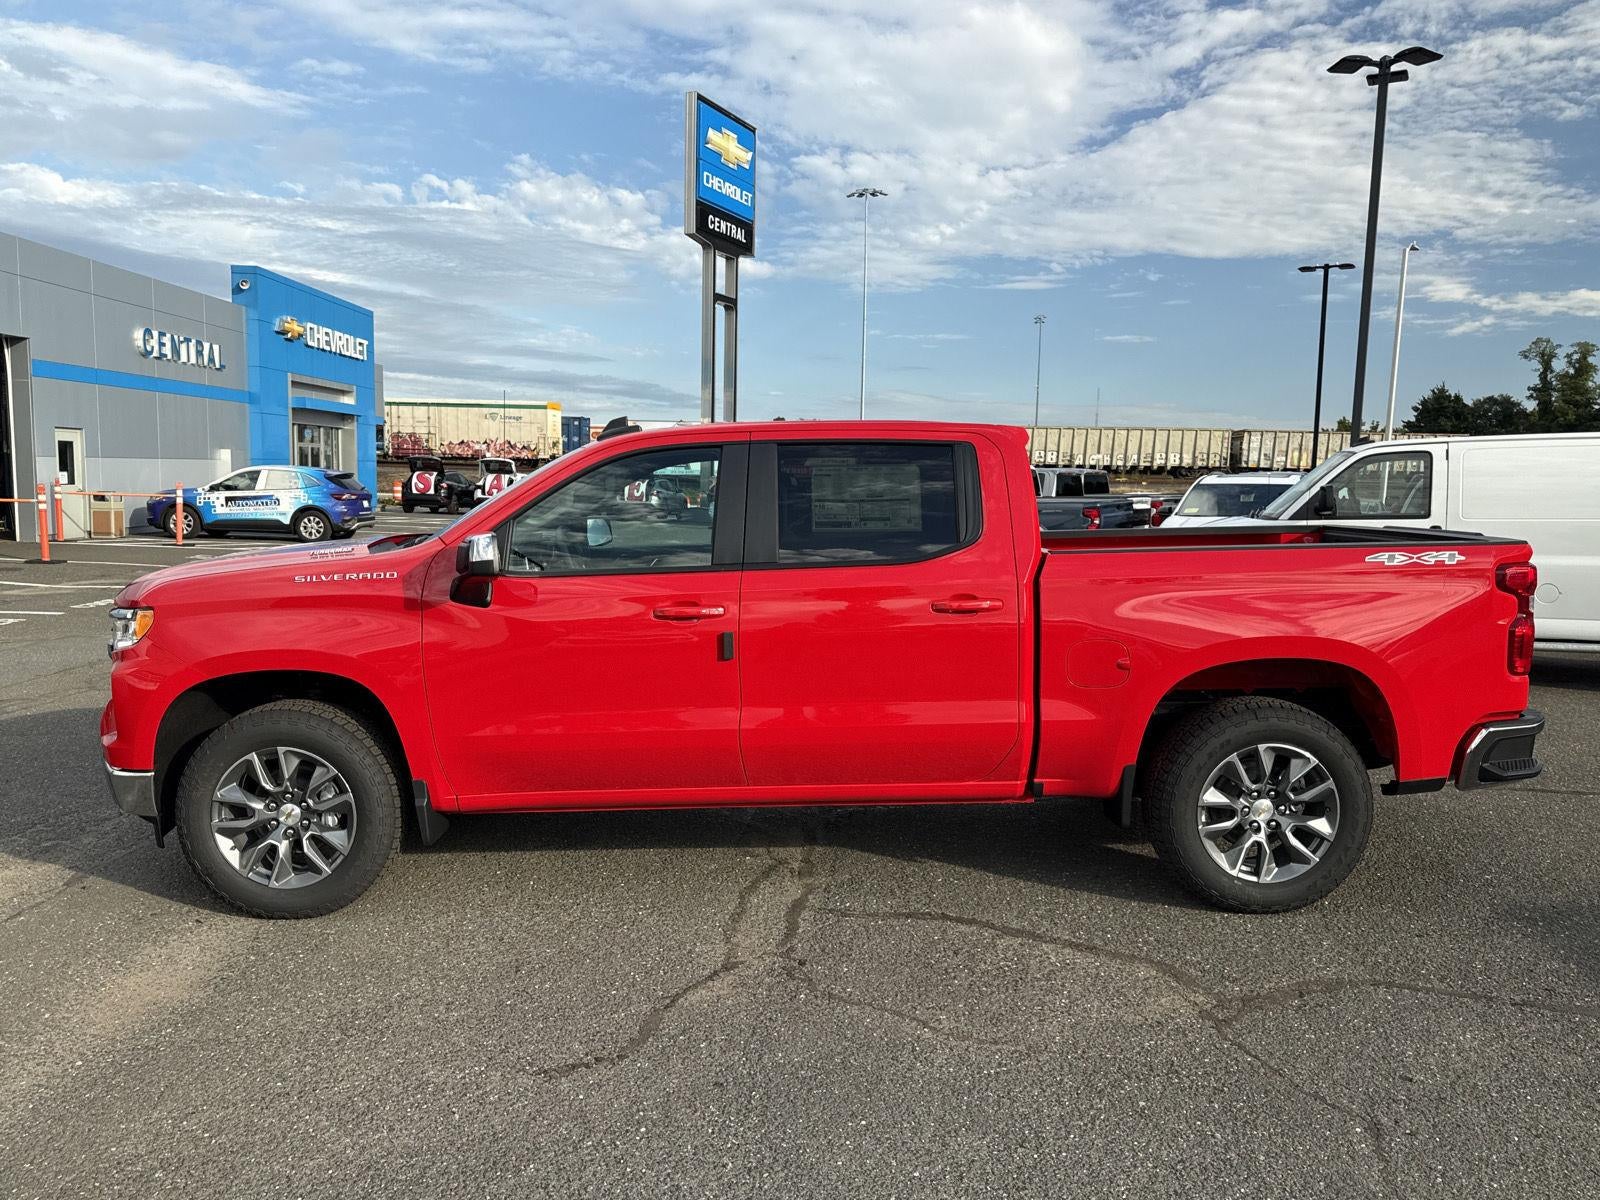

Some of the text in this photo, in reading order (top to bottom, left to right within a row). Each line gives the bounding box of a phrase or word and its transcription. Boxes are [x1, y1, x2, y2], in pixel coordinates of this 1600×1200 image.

[703, 171, 752, 207] CHEVROLET
[708, 214, 747, 243] CENTRAL
[140, 327, 226, 370] CENTRAL
[306, 321, 369, 361] CHEVROLET
[499, 414, 523, 422] Lneage
[414, 471, 434, 494] S
[486, 473, 504, 496] A
[227, 499, 279, 508] AUTOMATED
[1365, 551, 1466, 565] 4X4
[294, 571, 398, 583] SILVERADO
